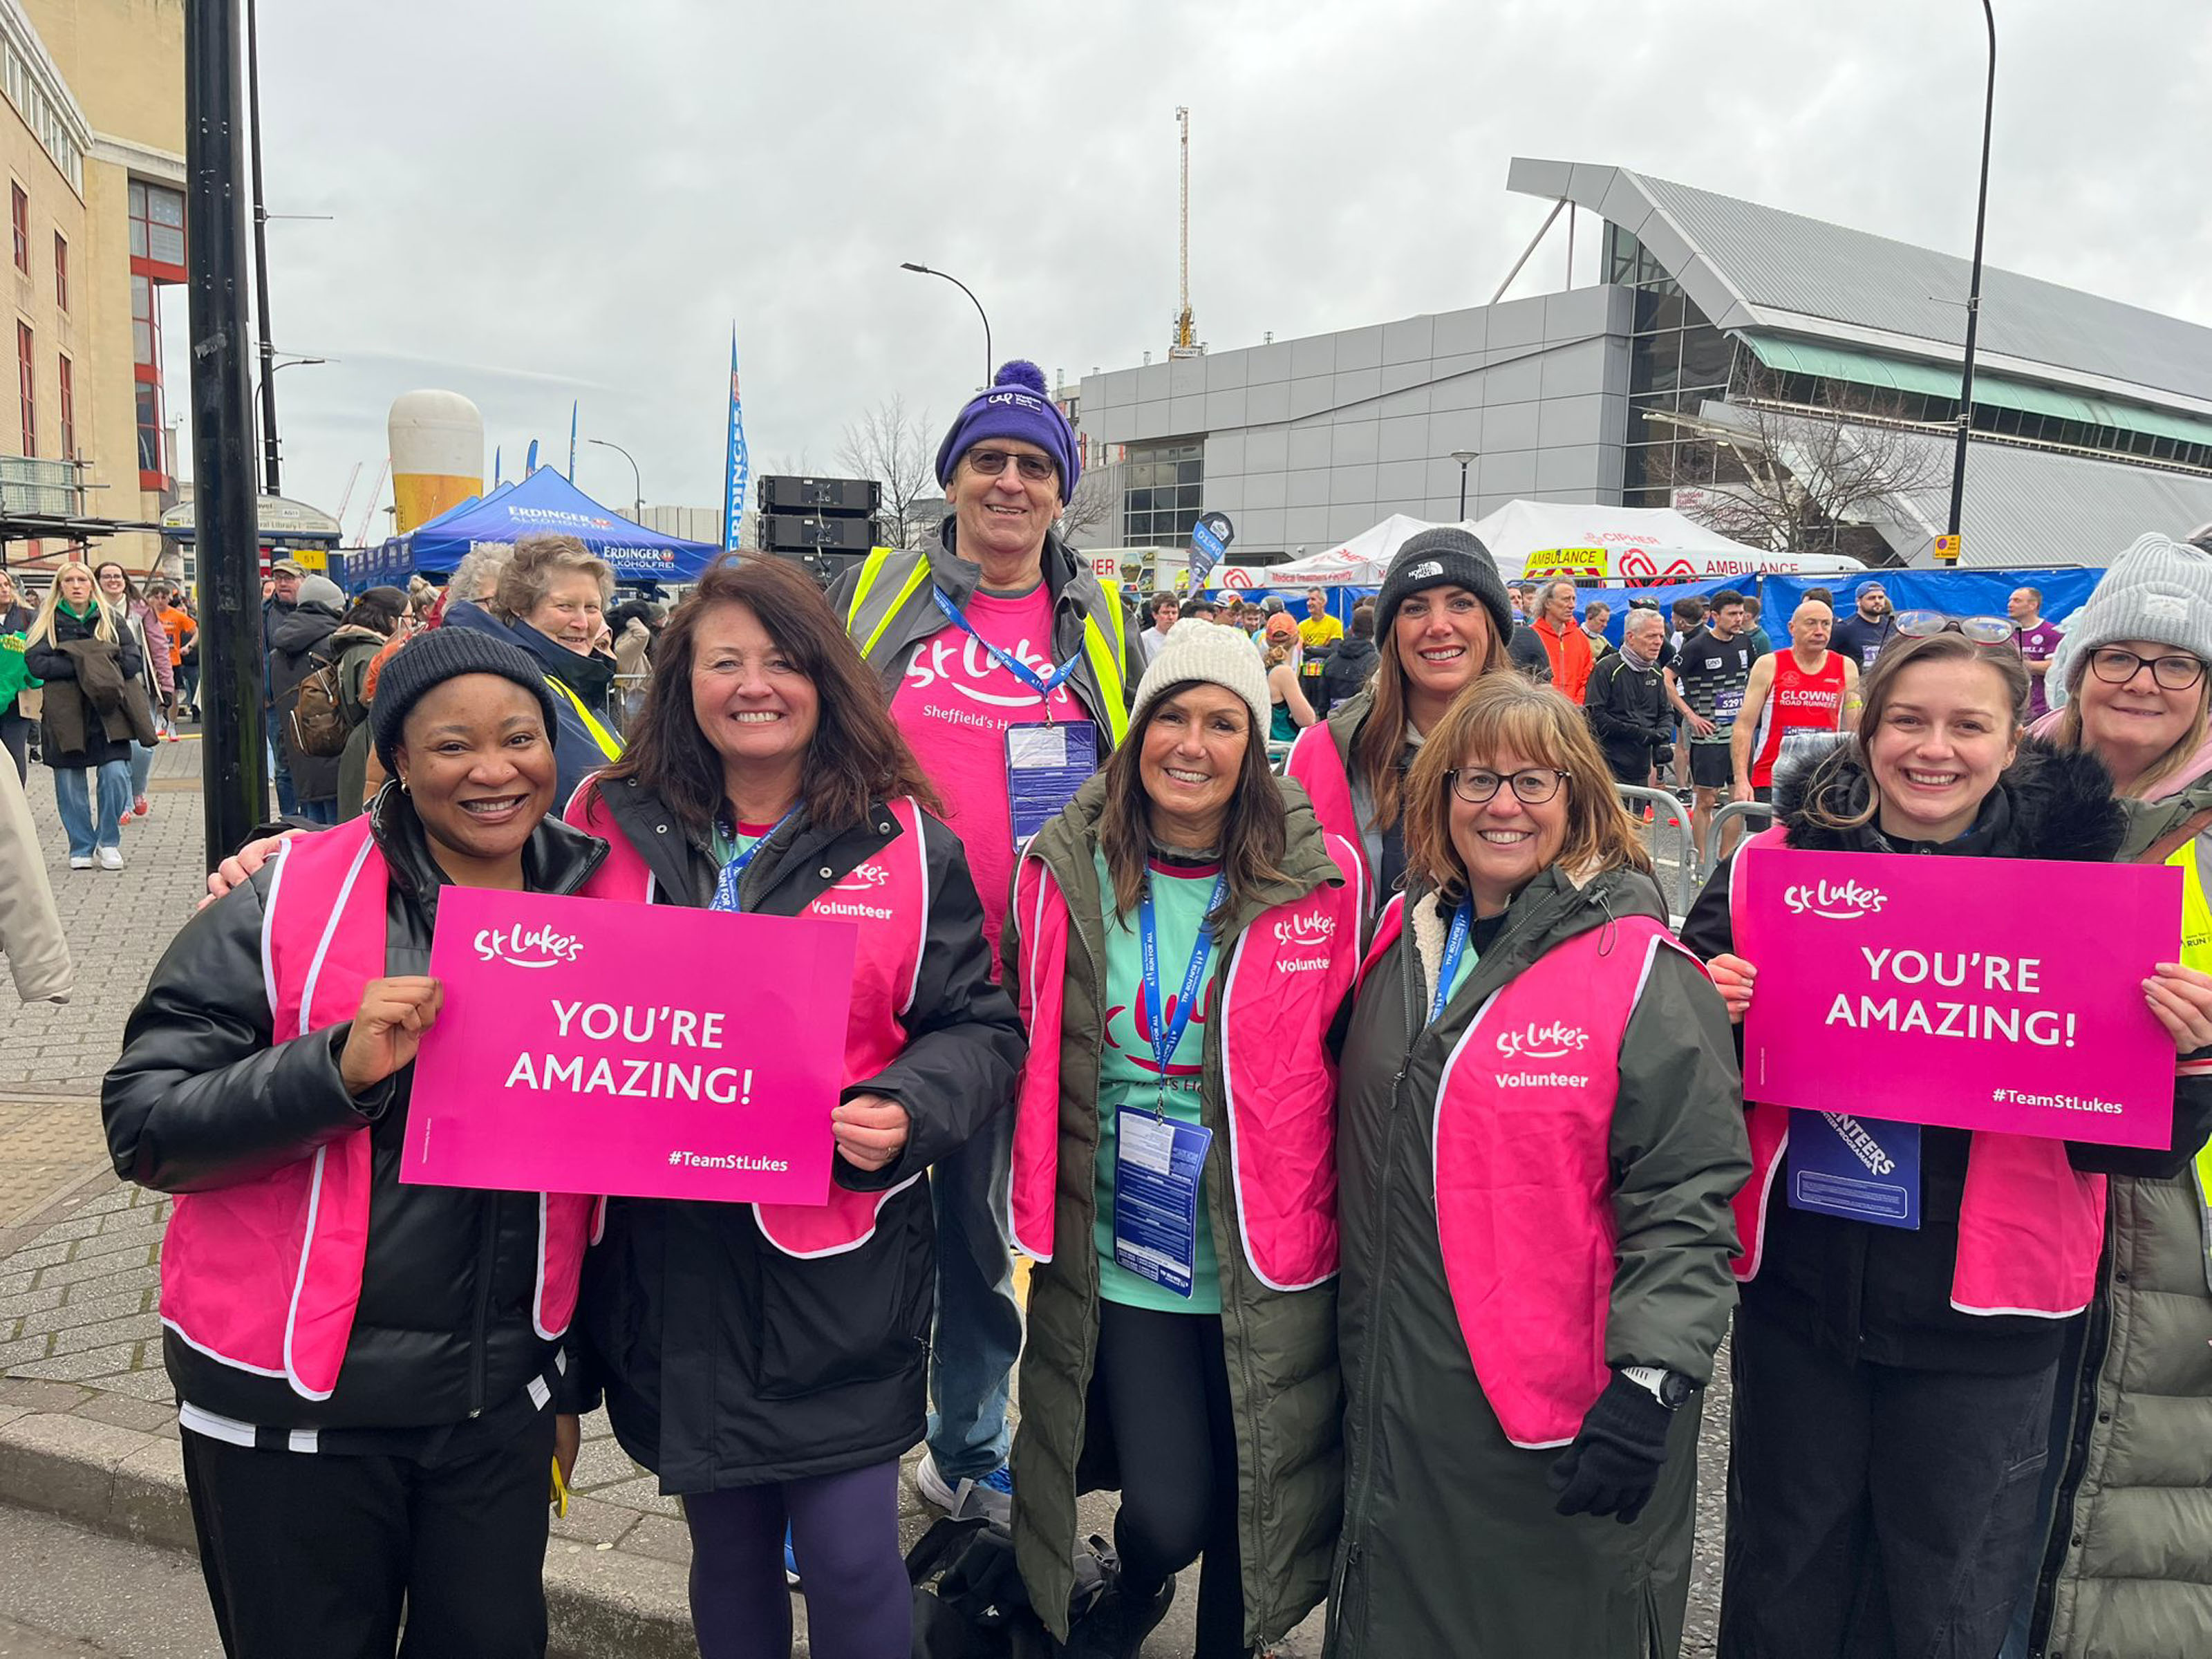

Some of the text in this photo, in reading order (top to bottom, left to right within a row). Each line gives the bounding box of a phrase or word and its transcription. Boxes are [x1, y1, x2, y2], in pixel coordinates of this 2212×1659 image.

[729, 407, 744, 552] ERDINGER
[509, 505, 589, 523] ERDINGER
[1603, 532, 1660, 545] CIPHER
[603, 546, 659, 561] ERDINGER
[1531, 551, 1597, 565] AMBULANCE
[1706, 560, 1799, 574] AMBULANCE
[906, 632, 1069, 704] St Lukes
[924, 705, 993, 729] Sheffield's
[720, 887, 731, 906] FOR
[1785, 879, 1888, 914] St Luke's
[812, 899, 893, 920] Volunteer
[1275, 910, 1335, 946] St Luke's
[474, 923, 584, 962] St Luke's
[1448, 938, 1456, 953] FOR
[2187, 937, 2206, 947] RUN
[1445, 953, 1453, 965] ALL
[1861, 946, 2041, 994] YOU'RE
[1185, 975, 1194, 991] FOR
[1181, 991, 1189, 1003] ALL
[551, 1000, 725, 1049] YOU'RE
[1826, 993, 2075, 1047] AMAZING!
[1497, 1021, 1589, 1058] St Luke's
[504, 1052, 753, 1105] AMAZING!
[1495, 1071, 1588, 1088] Volunteer
[1993, 1088, 2122, 1114] #TeamStLukes
[1825, 1112, 1895, 1175] NTEERS
[668, 1151, 787, 1172] #TeamStLukes
